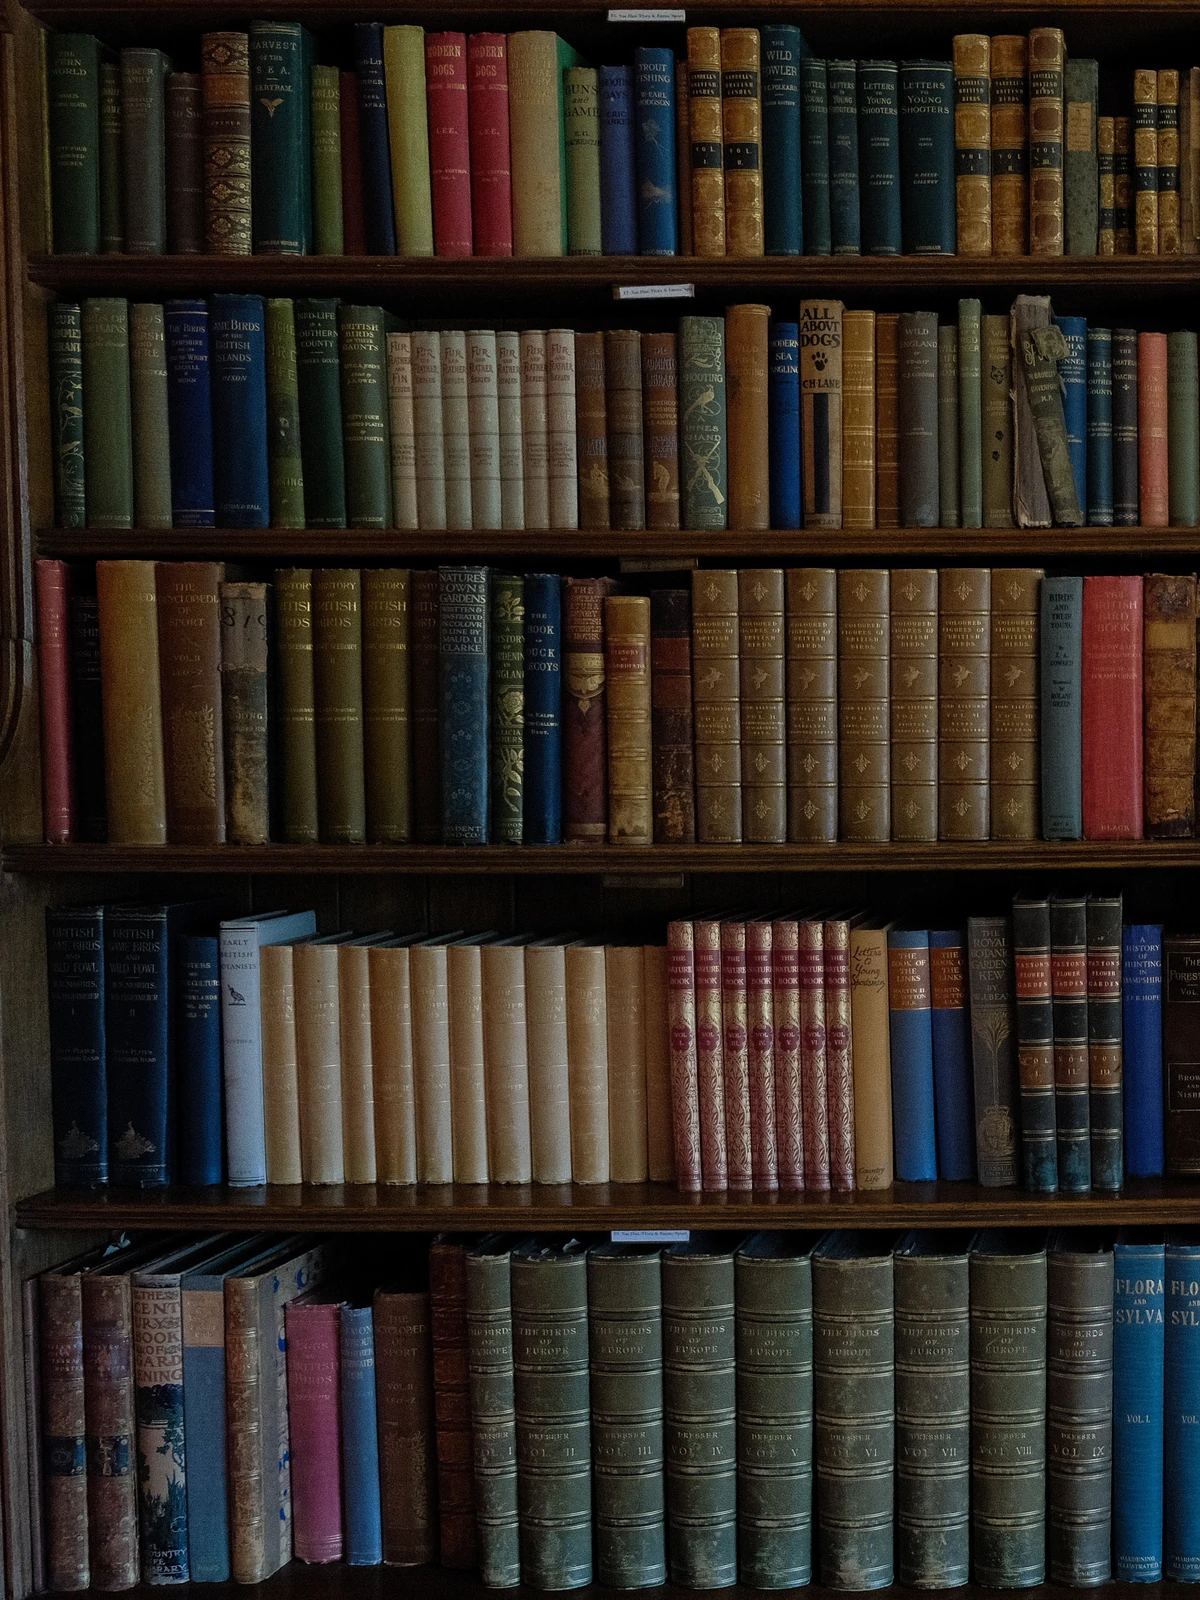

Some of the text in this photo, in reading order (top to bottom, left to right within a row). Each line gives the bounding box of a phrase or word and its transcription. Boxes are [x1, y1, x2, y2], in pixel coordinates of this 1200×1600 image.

[767, 50, 791, 61] WILD
[433, 64, 455, 76] DOGS
[475, 64, 496, 76] DOGS
[639, 64, 666, 72] TROUT
[863, 82, 894, 91] LETTERS
[903, 82, 945, 90] LETTERS
[866, 97, 892, 105] YOUNG
[907, 95, 941, 105] YOUNG
[565, 107, 600, 118] GAME
[862, 107, 897, 116] SHOOTERS
[902, 105, 949, 115] SHOOTERS
[802, 307, 834, 320] ALL
[230, 320, 260, 332] BIRDS
[801, 321, 839, 333] ABOVT
[801, 333, 841, 347] DOGS
[775, 352, 792, 361] SEA
[446, 584, 476, 593] OWN
[440, 594, 485, 604] GARDENS
[528, 625, 554, 635] BOOK
[973, 938, 1006, 947] ROYAL
[1126, 944, 1159, 952] HISTORY
[979, 971, 1004, 981] KEW
[1116, 1279, 1164, 1295] FLORA
[1116, 1310, 1163, 1324] SYLVA
[135, 1332, 179, 1343] BOOK
